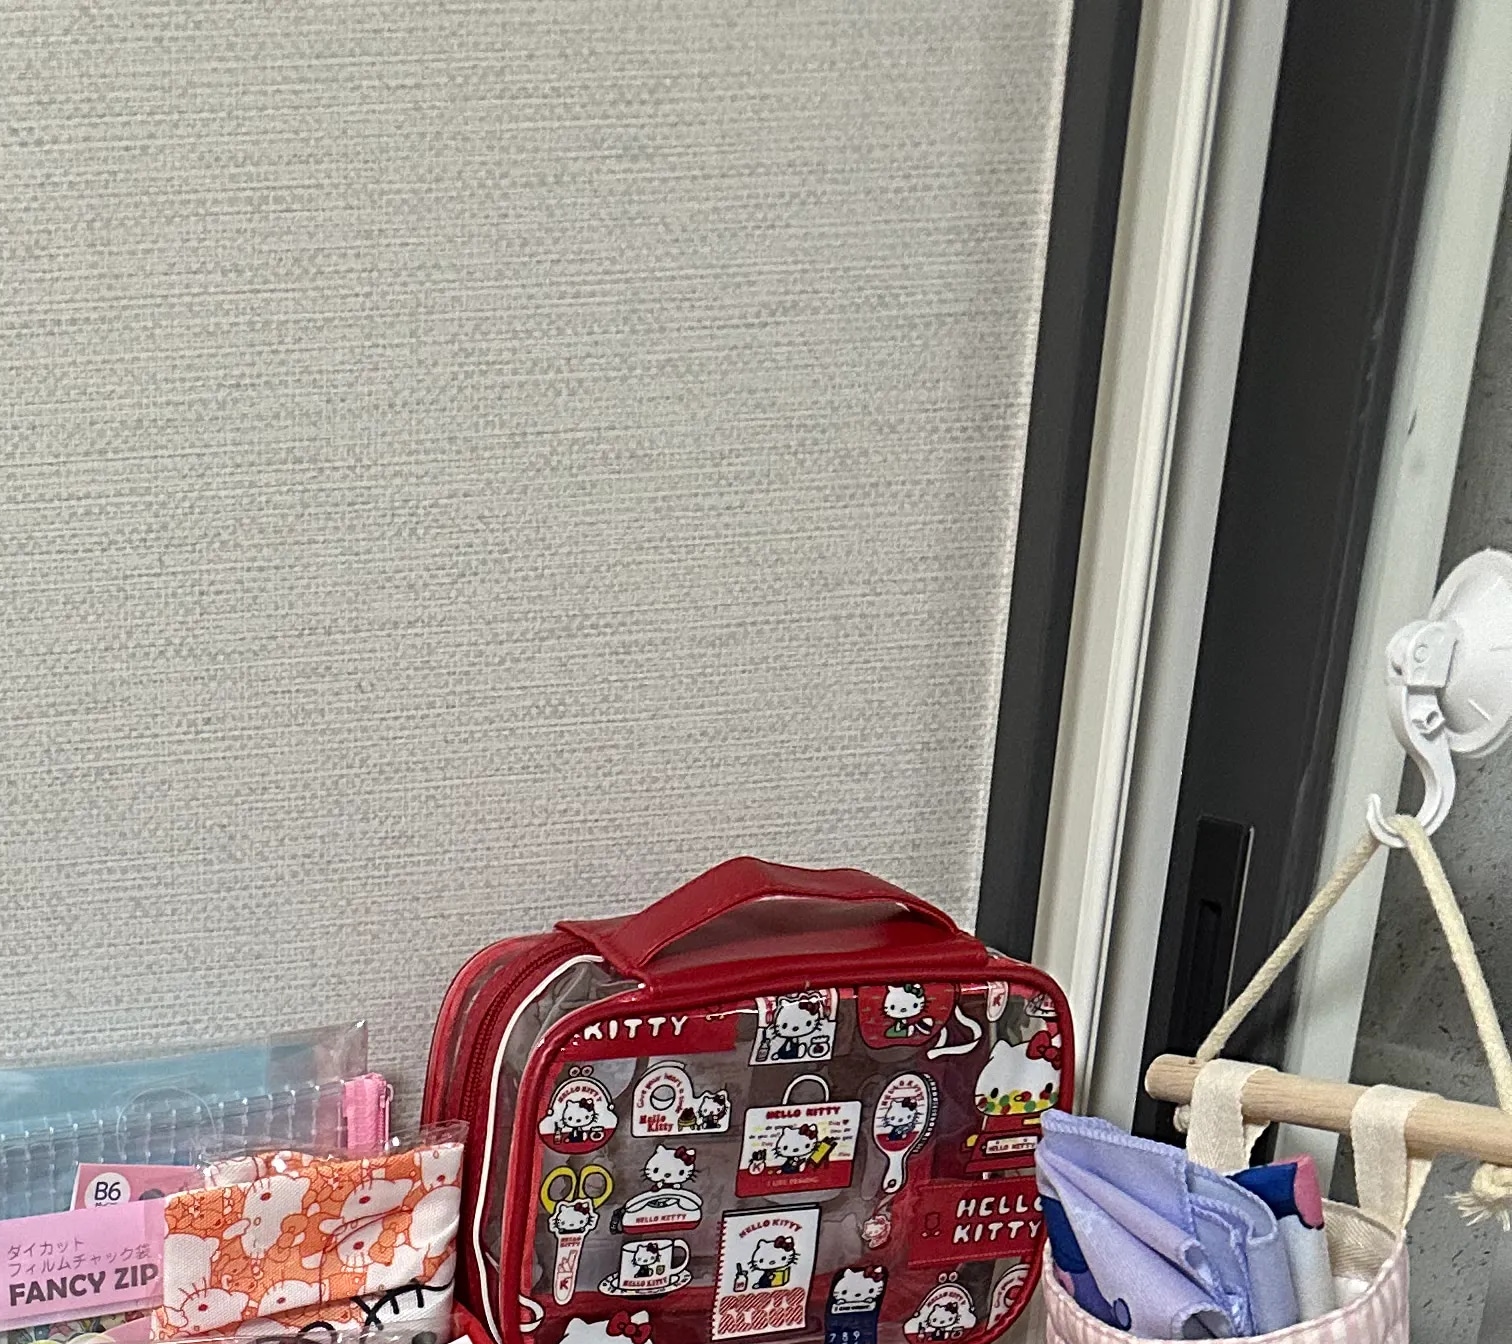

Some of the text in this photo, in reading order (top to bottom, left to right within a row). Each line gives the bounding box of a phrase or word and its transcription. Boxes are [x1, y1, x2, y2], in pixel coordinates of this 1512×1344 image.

[584, 1015, 688, 1040] KITTY
[639, 1115, 666, 1124] Hello
[766, 1106, 841, 1120] HELLO KITTY
[647, 1122, 674, 1132] Kitty
[94, 1181, 121, 1201] B6
[635, 1213, 687, 1223] HELLO KITTY
[739, 1218, 802, 1239] HELLO KITTY
[953, 1220, 1042, 1243] KITTY
[8, 1236, 85, 1261] ダイカット
[8, 1244, 151, 1277] フィルムチャック袋
[9, 1263, 159, 1306] FANCY ZIP
